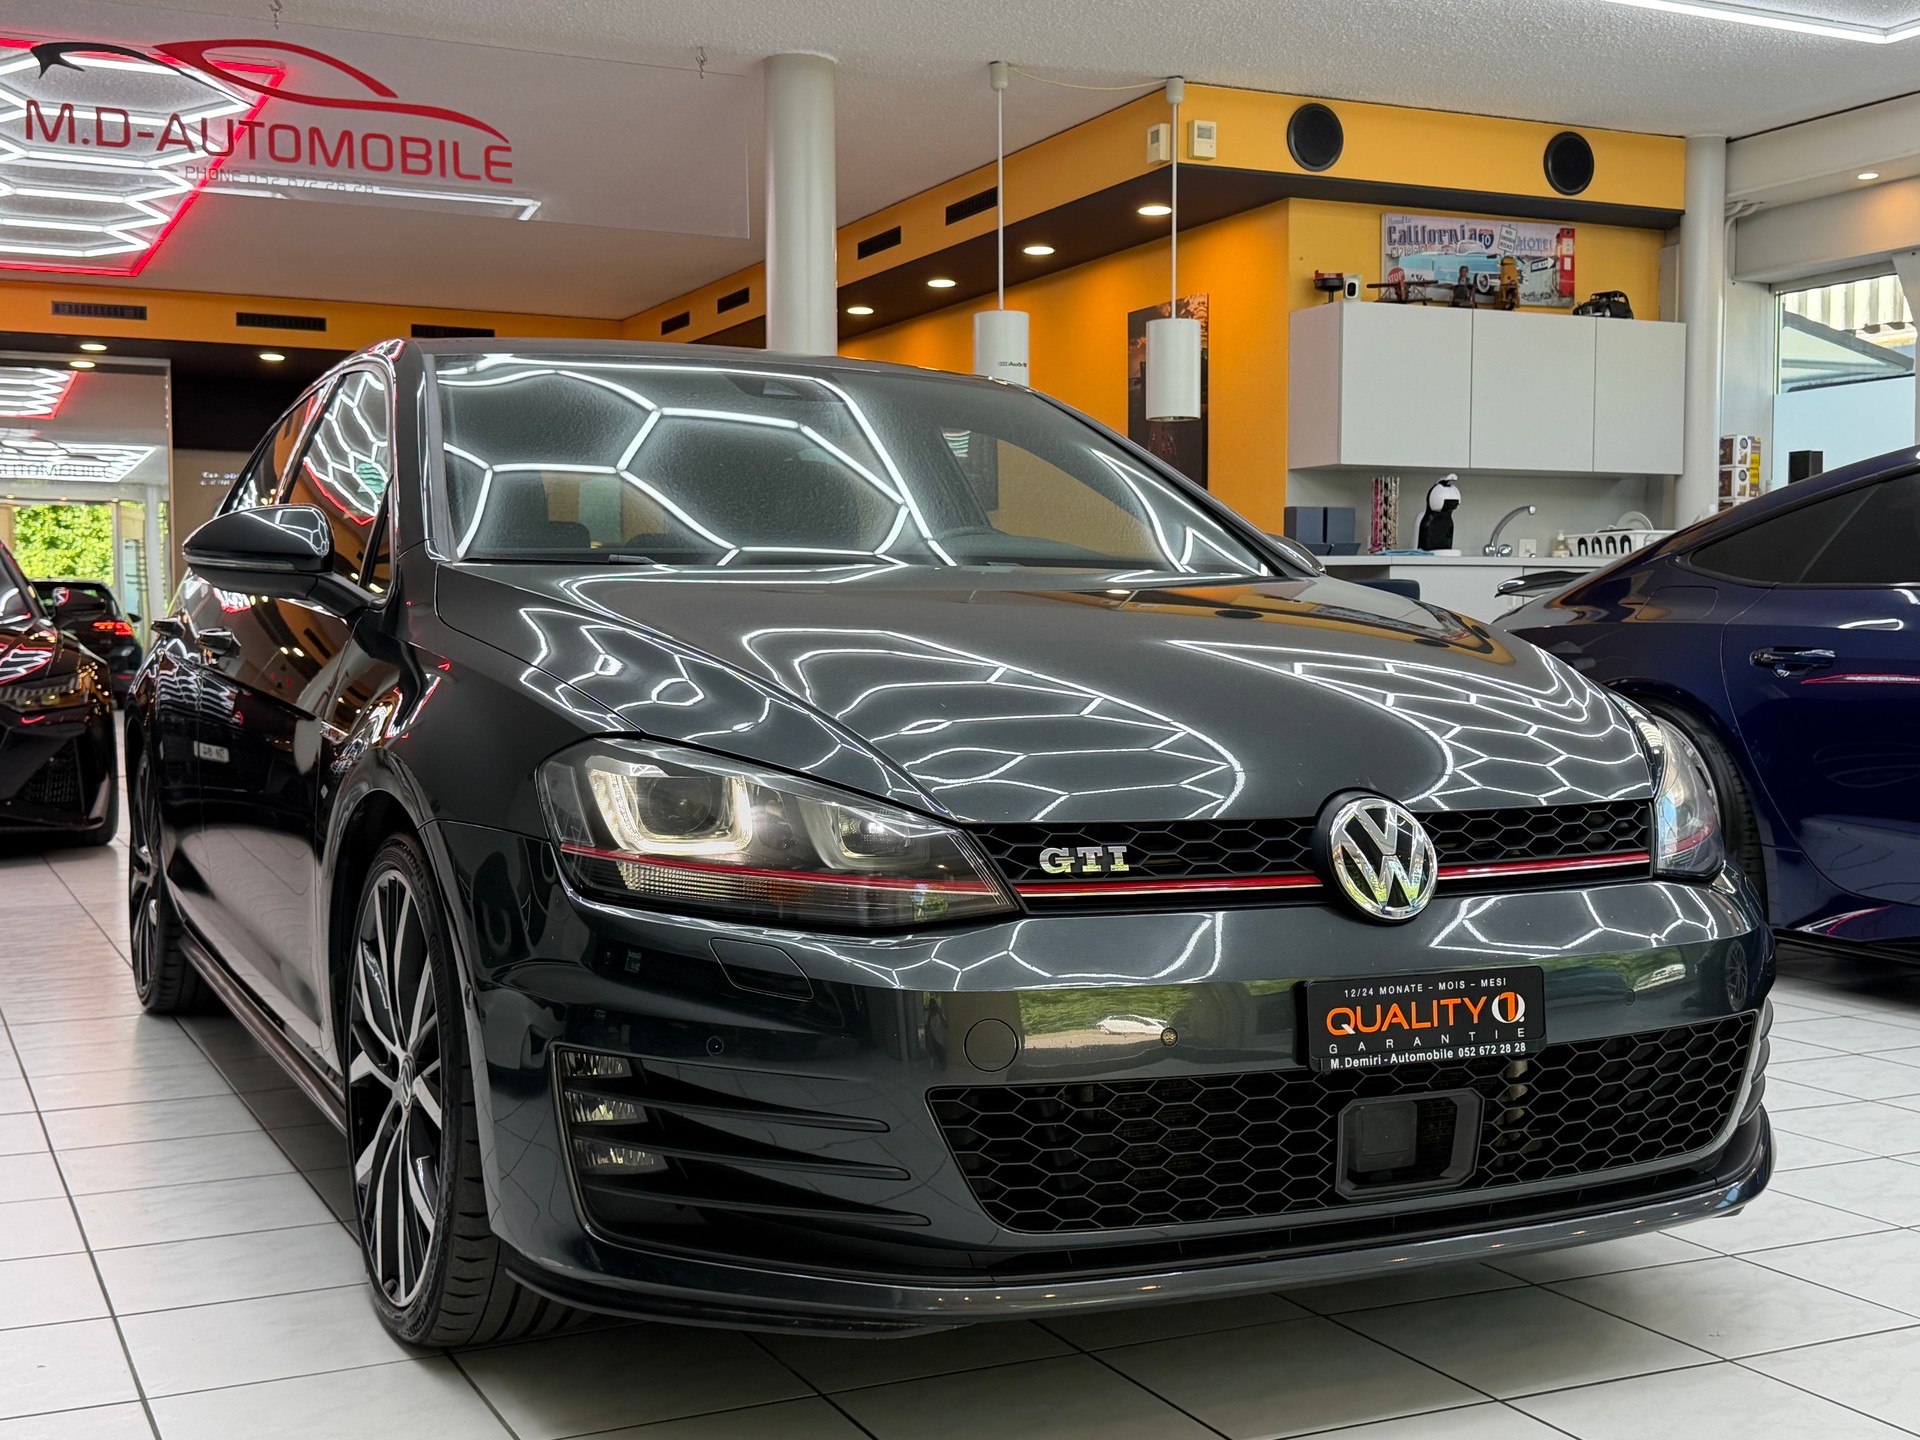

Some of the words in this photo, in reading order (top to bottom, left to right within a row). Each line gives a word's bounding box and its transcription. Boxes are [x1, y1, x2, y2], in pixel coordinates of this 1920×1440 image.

[25, 99, 514, 185] M.D-AUTOMOBILE
[184, 166, 241, 183] PHONE
[1387, 224, 1477, 246] California
[1039, 845, 1130, 874] GTI
[1344, 987, 1374, 998] 12/24
[1379, 983, 1423, 995] MONATE
[1438, 980, 1466, 991] MOIS
[1480, 977, 1507, 988] MESI
[1326, 995, 1488, 1036] QUALITY
[1328, 1027, 1526, 1055] GARANTIE
[1458, 1046, 1476, 1058] 052
[1479, 1044, 1497, 1056] 672
[1499, 1043, 1512, 1054] 28
[1514, 1042, 1527, 1053] 28
